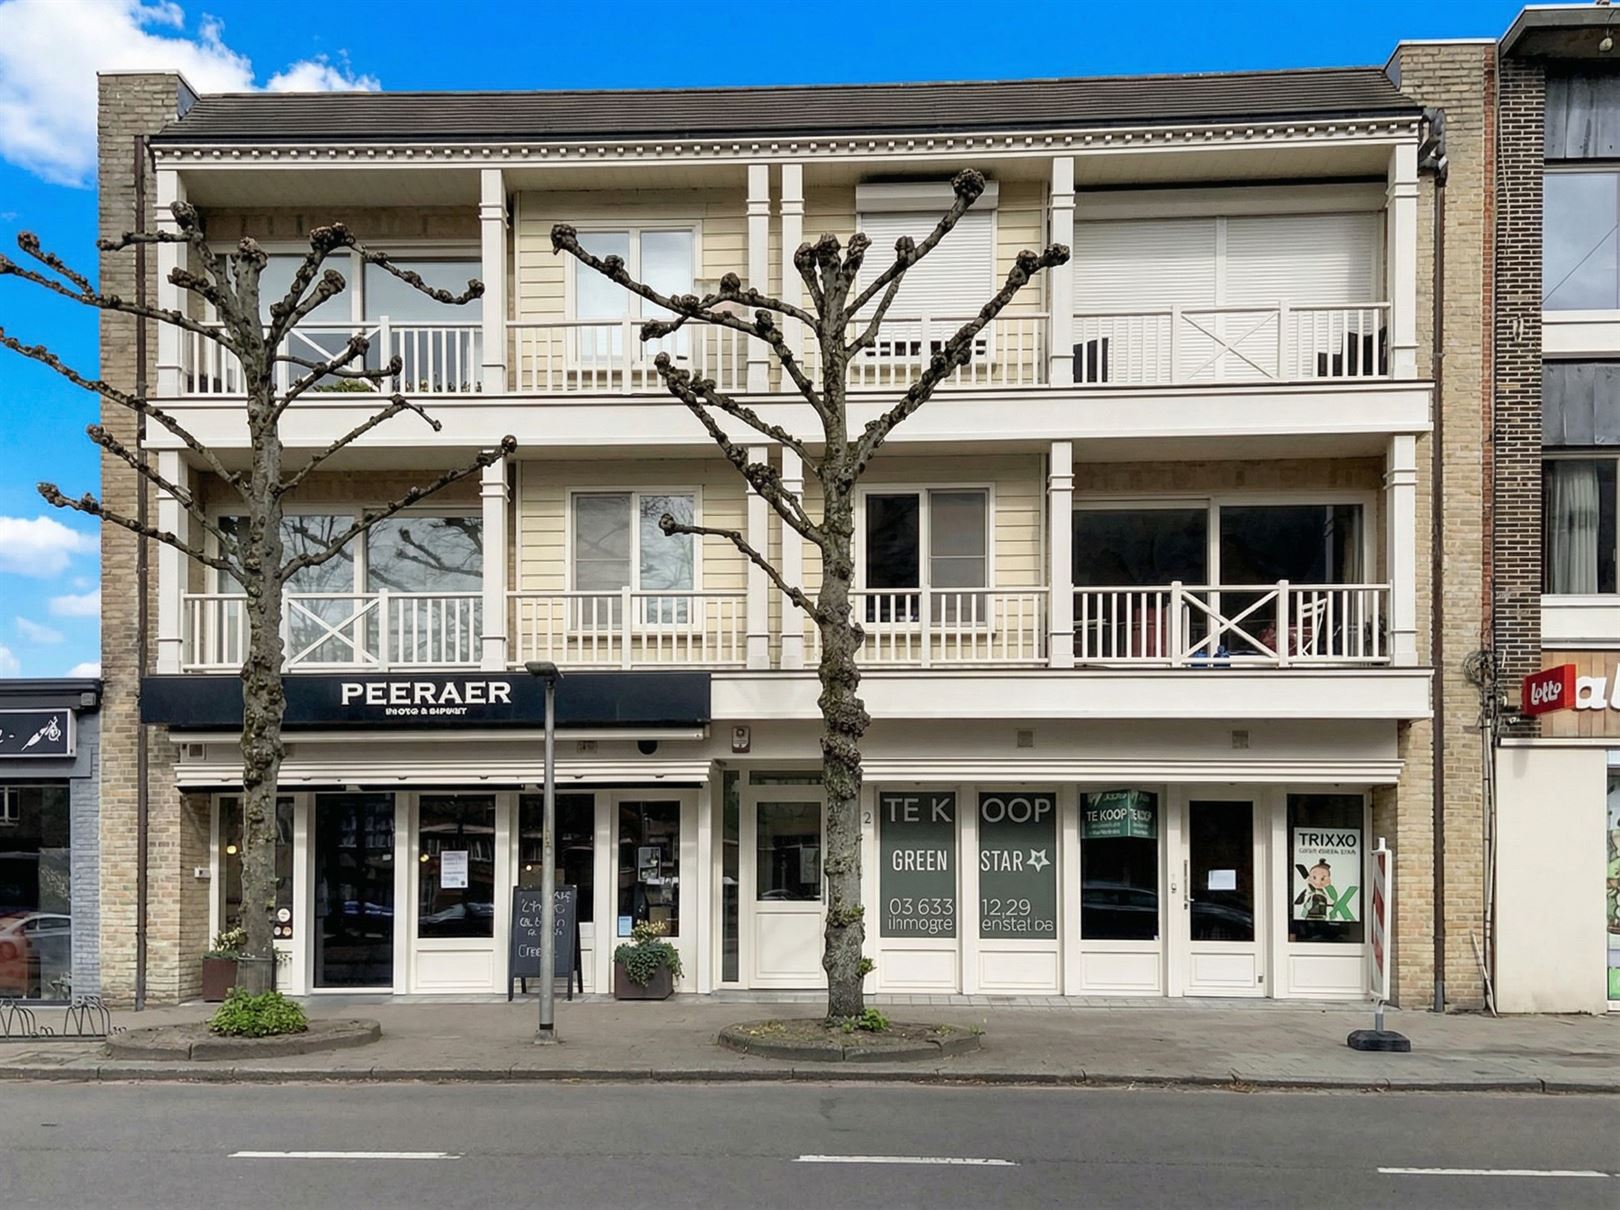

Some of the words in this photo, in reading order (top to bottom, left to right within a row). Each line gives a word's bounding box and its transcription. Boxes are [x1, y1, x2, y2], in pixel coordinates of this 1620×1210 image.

[341, 681, 512, 706] PEERAER
[863, 811, 872, 824] 2
[884, 798, 920, 823] TE
[1086, 810, 1099, 822] TE
[1099, 807, 1128, 821] KOOP
[1298, 832, 1357, 848] TRIXXO
[892, 849, 948, 872] GREEN
[980, 849, 1024, 872] STAR
[889, 898, 913, 915] 03
[918, 898, 954, 915] 633
